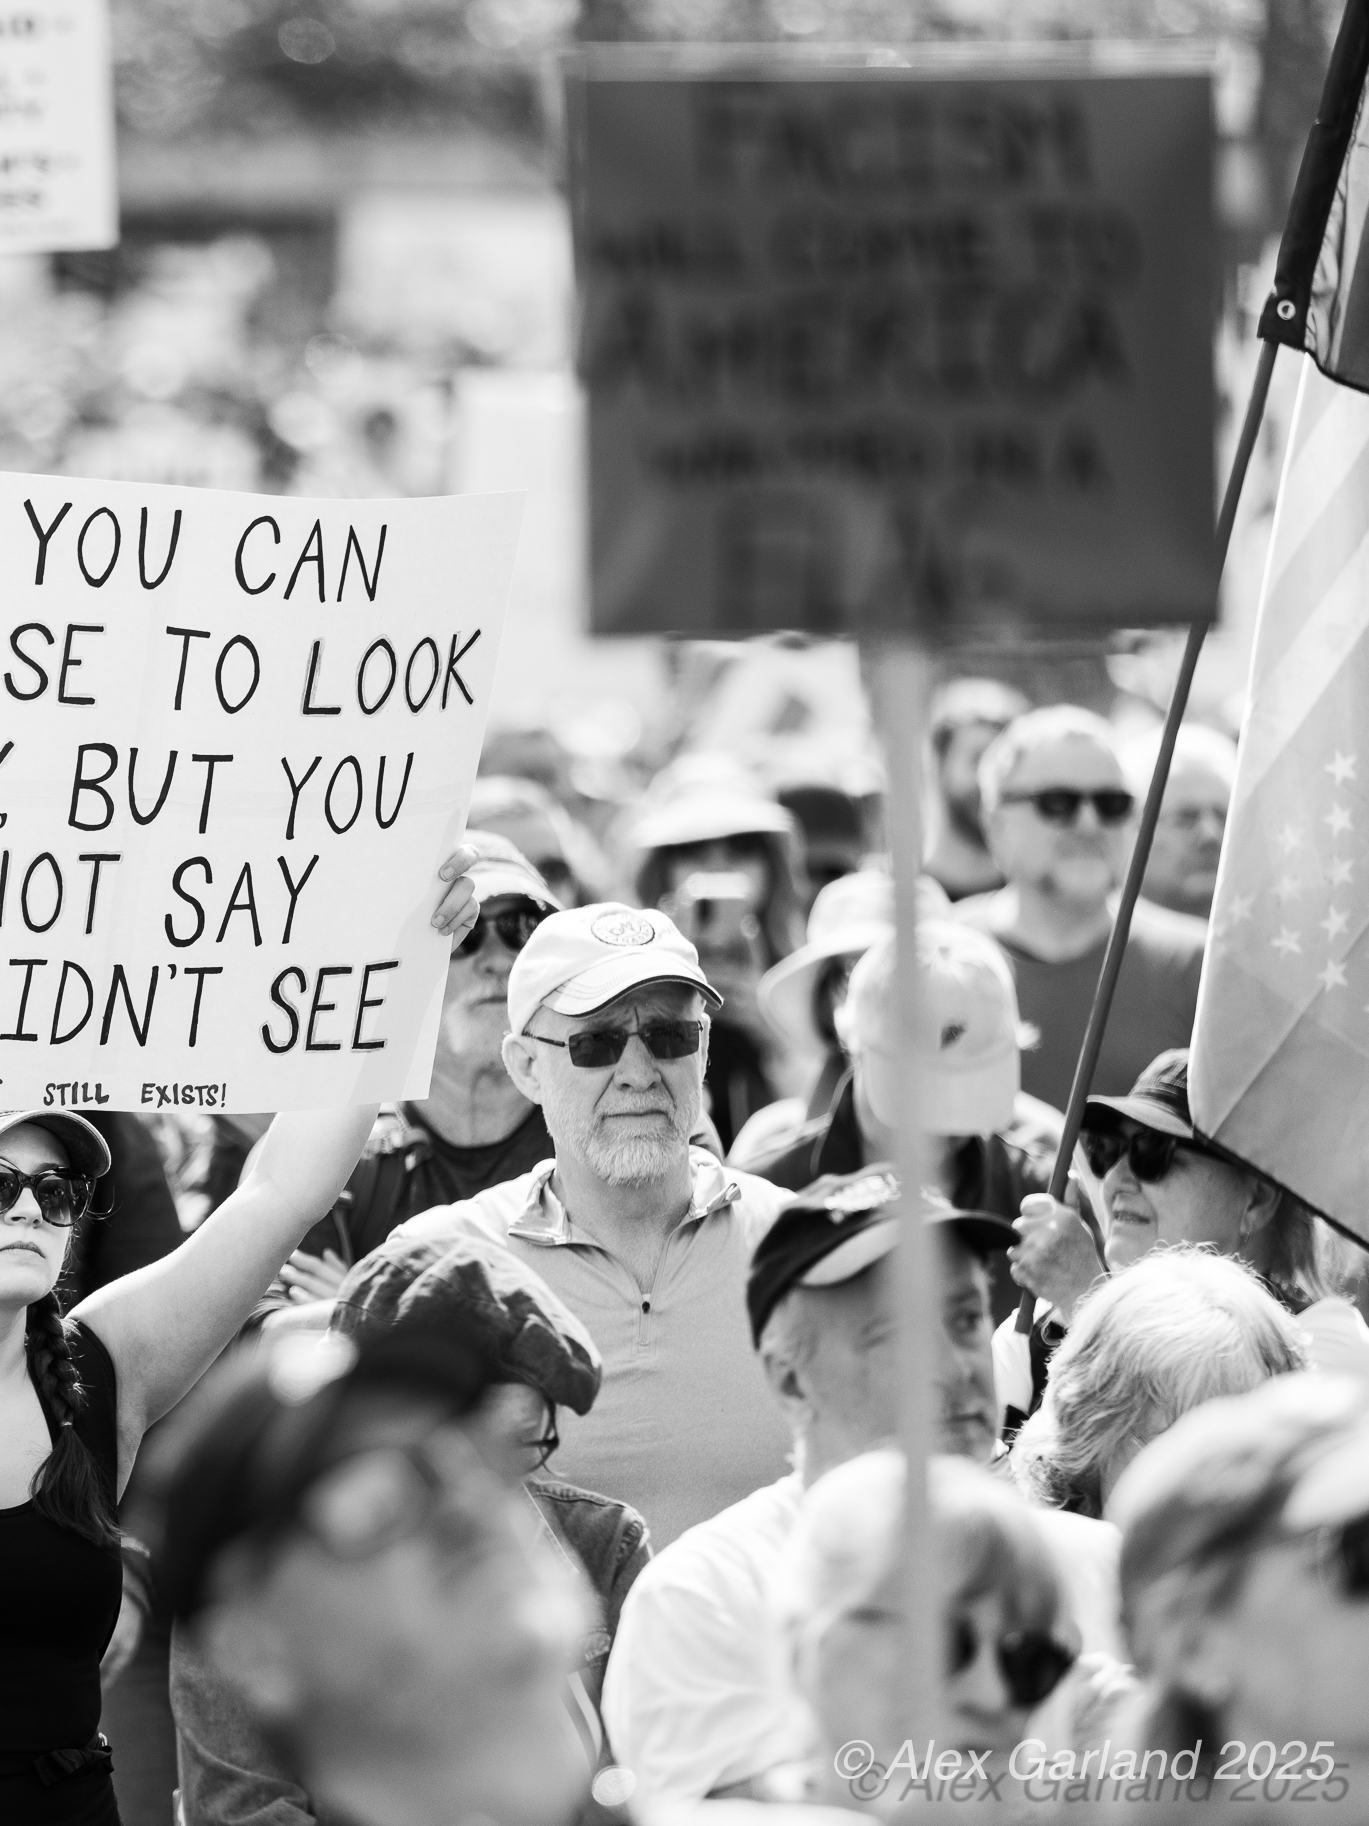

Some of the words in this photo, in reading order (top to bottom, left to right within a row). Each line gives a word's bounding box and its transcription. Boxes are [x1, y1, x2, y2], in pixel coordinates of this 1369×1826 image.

[23, 498, 183, 590] YOU
[234, 515, 388, 604] CAN
[165, 625, 261, 715] TO
[302, 628, 482, 716] LOOK
[67, 742, 234, 835] BUT
[280, 752, 415, 841] YOU
[164, 854, 320, 948] SAY
[261, 960, 399, 1054] SEE
[43, 1081, 110, 1107] STILL
[140, 1082, 227, 1109] EXISTS!
